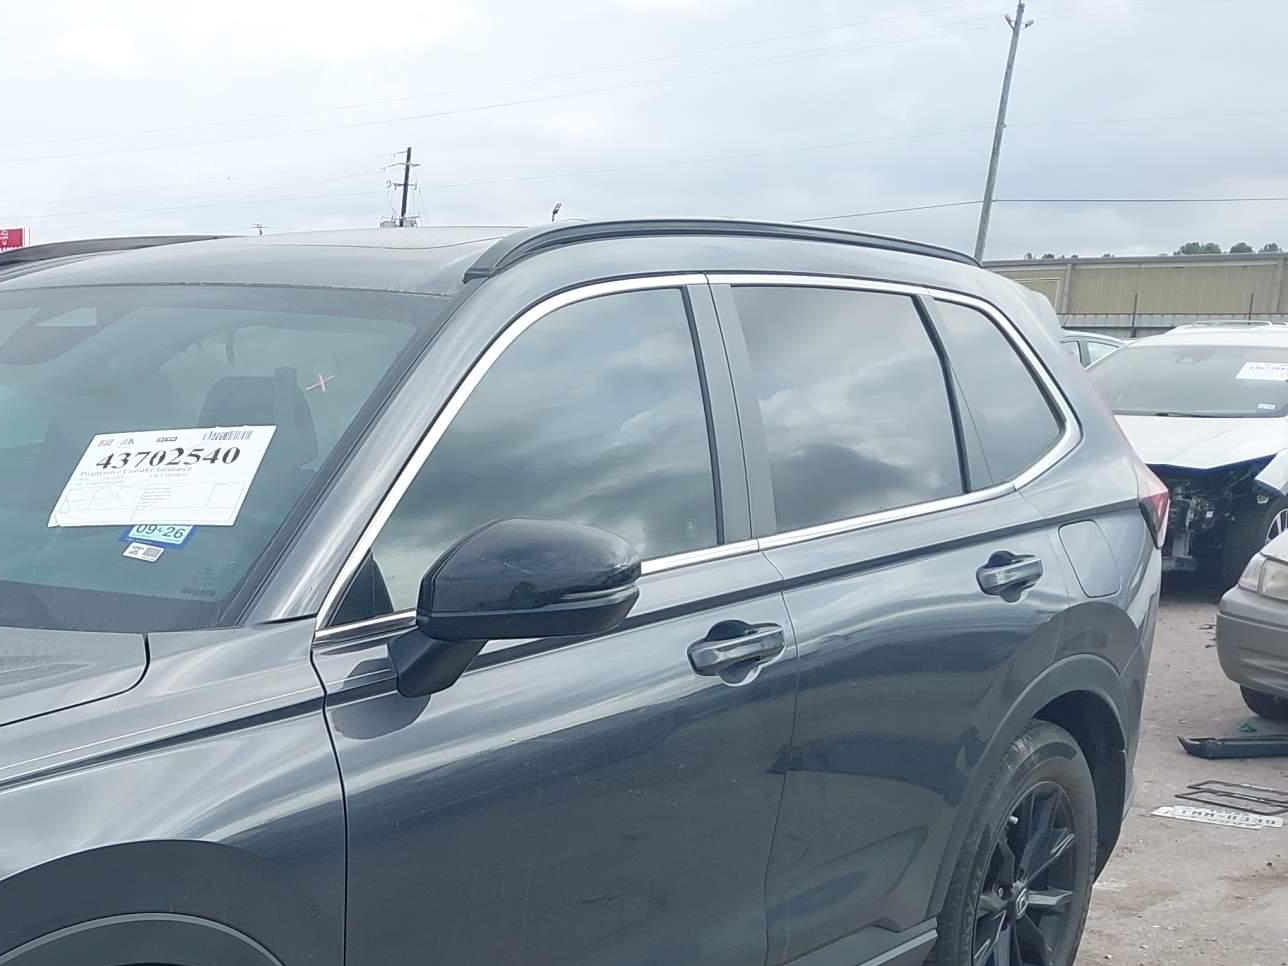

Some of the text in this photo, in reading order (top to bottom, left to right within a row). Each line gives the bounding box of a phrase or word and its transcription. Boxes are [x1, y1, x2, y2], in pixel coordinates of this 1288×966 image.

[95, 446, 241, 470] 43702540
[136, 524, 186, 539] 09 26
